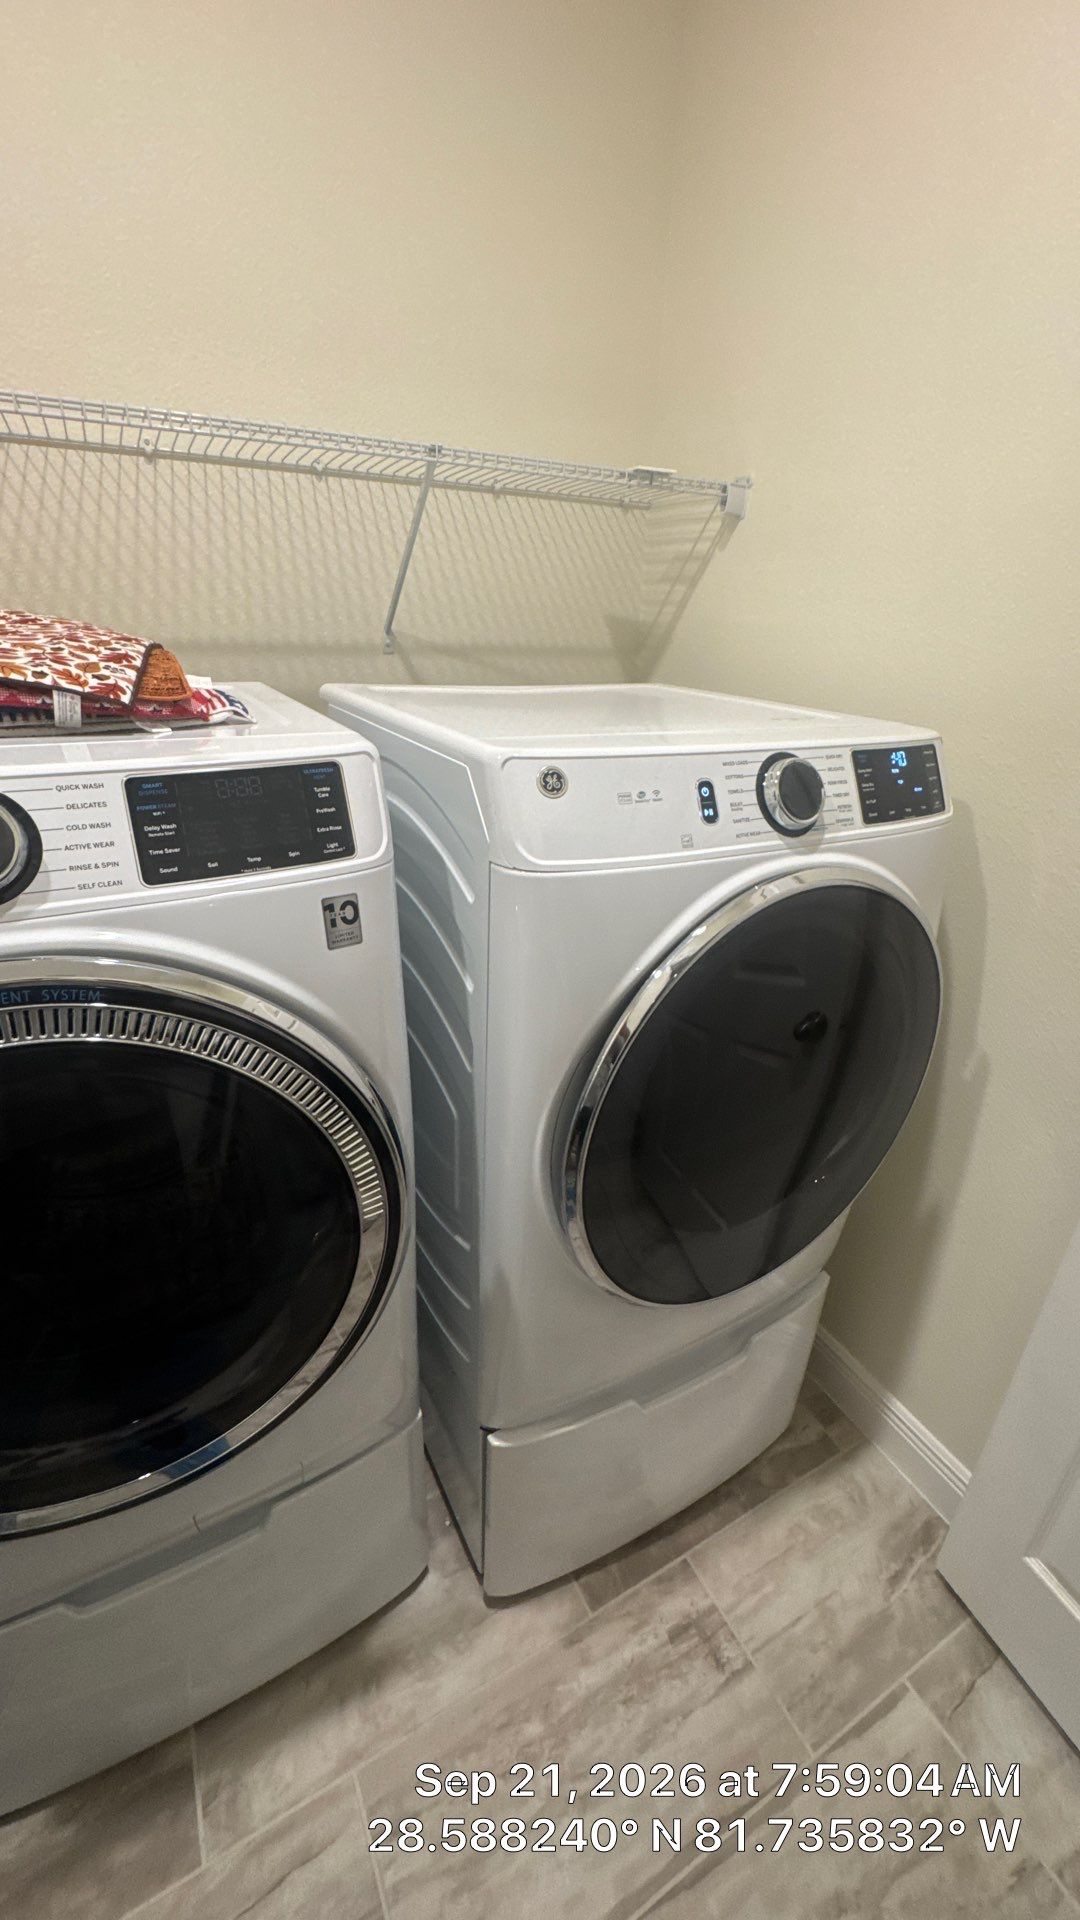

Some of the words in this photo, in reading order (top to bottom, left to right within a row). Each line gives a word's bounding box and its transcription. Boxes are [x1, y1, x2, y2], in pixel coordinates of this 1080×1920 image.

[55, 784, 80, 792] QUICK
[66, 802, 107, 810] DELICATES
[64, 843, 92, 851] ACTIVE
[97, 880, 123, 888] CLEAN
[323, 900, 359, 928] 10
[0, 990, 31, 1004] ENT
[41, 989, 101, 1001] SYSTEM
